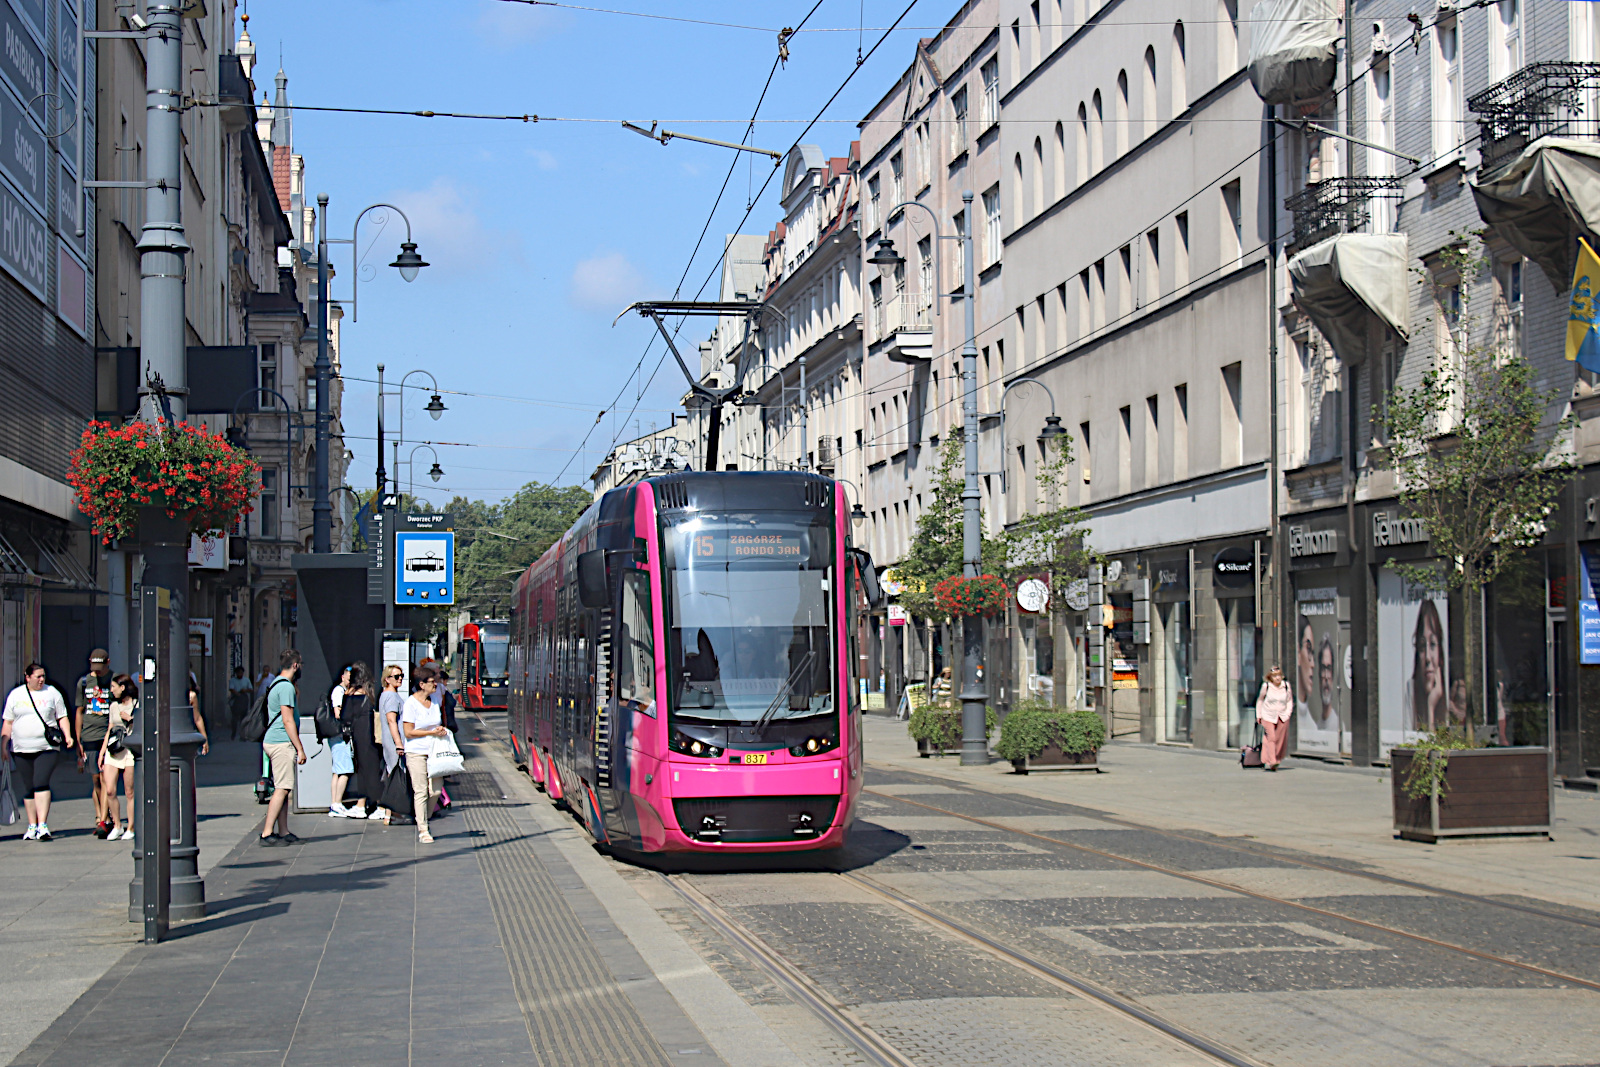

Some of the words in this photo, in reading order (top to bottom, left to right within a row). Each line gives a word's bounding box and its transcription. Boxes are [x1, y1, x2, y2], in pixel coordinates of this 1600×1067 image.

[5, 22, 35, 90] PASIBUS
[15, 121, 37, 193] sinsay
[694, 535, 714, 557] 15
[730, 535, 783, 544] ZAGÓRZE
[735, 546, 774, 555] RONDO
[777, 546, 800, 555] JAN
[1225, 562, 1250, 571] Silcare
[746, 754, 765, 764] 837
